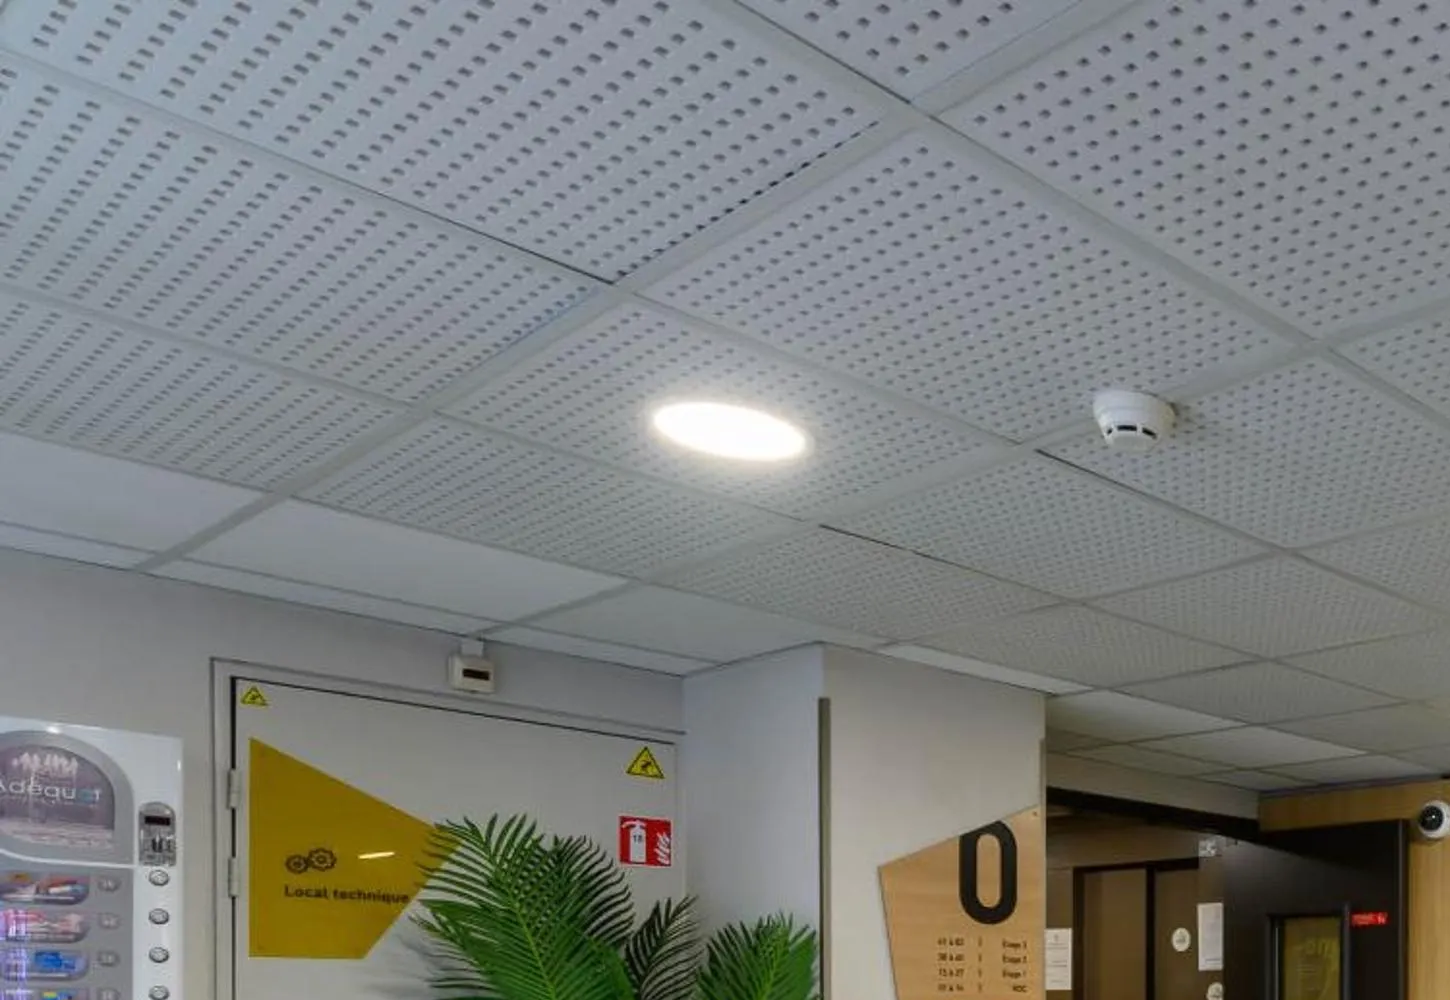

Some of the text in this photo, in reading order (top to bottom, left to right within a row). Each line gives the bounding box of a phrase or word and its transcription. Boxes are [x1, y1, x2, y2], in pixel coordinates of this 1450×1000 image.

[284, 885, 410, 905] Local technique
[959, 819, 1018, 925] 0
